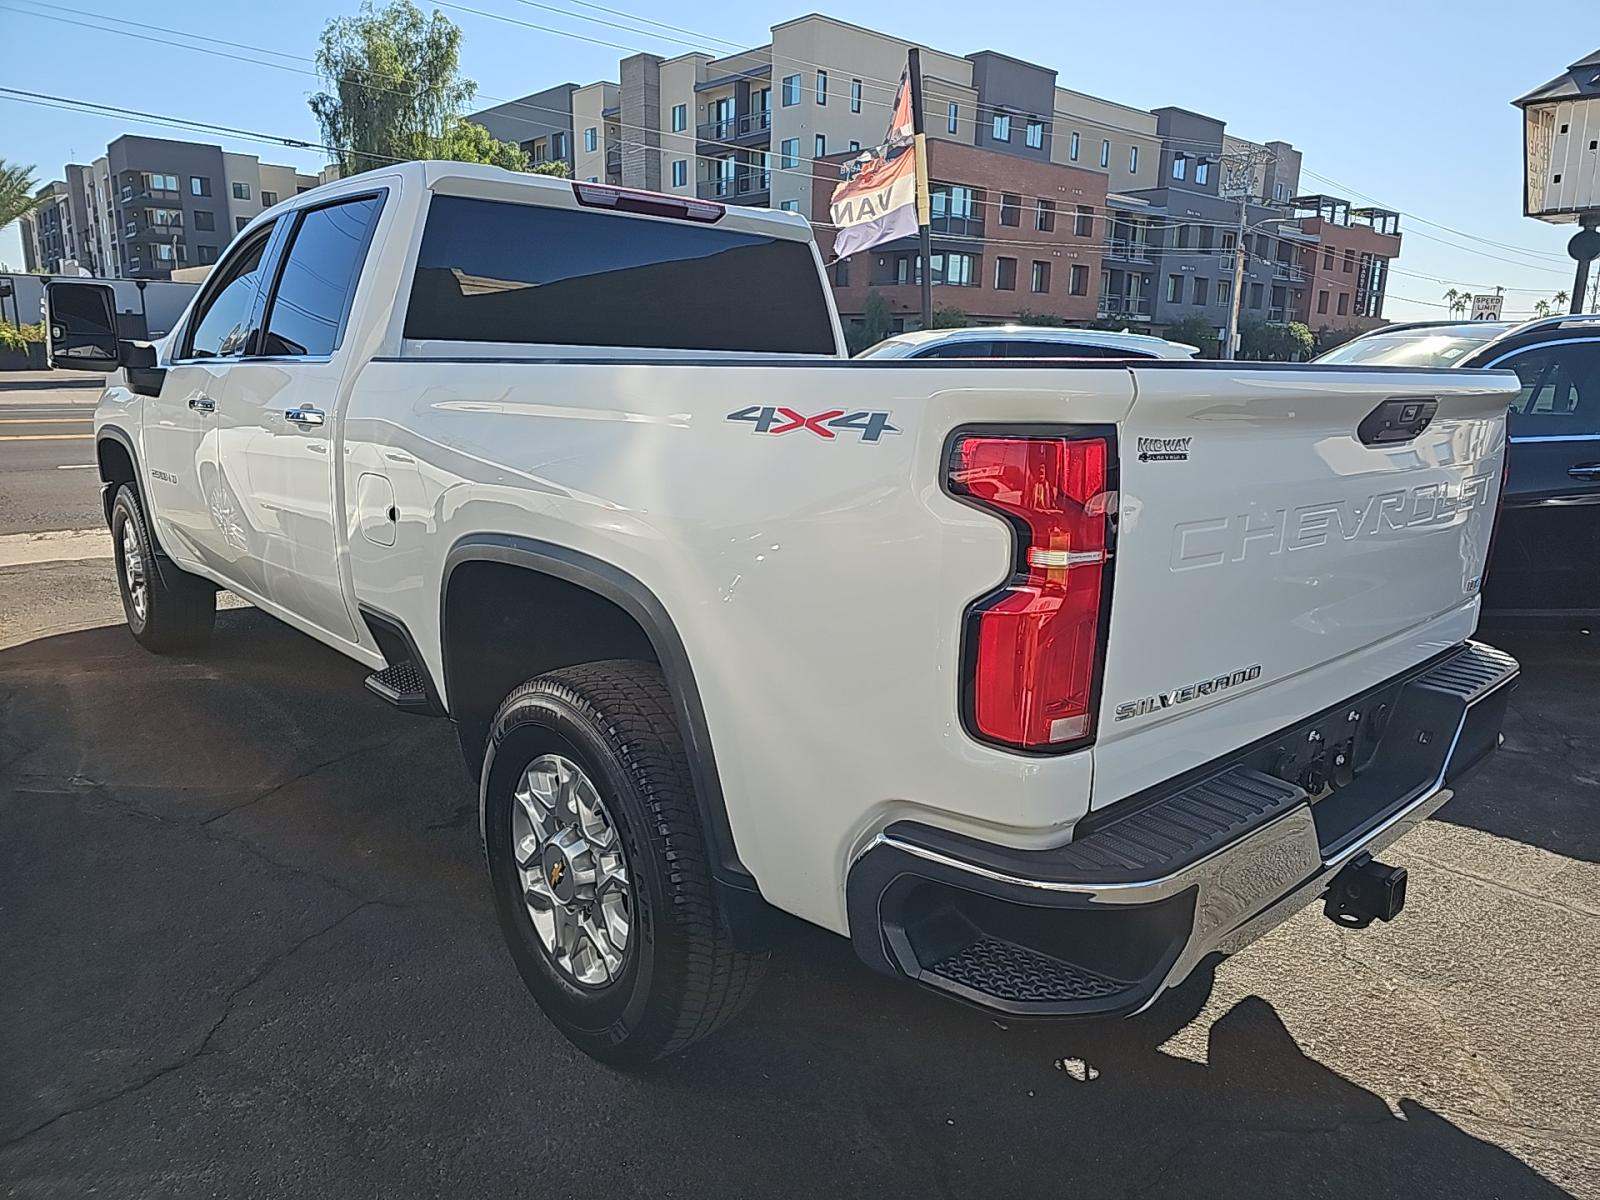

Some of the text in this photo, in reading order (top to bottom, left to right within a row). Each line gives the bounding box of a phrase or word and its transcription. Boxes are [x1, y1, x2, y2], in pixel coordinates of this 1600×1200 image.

[1475, 297, 1501, 305] SPEED
[1137, 437, 1193, 452] MIDWAY
[1169, 470, 1495, 573] CHEVROLET
[1115, 664, 1262, 721] SILVERADO
